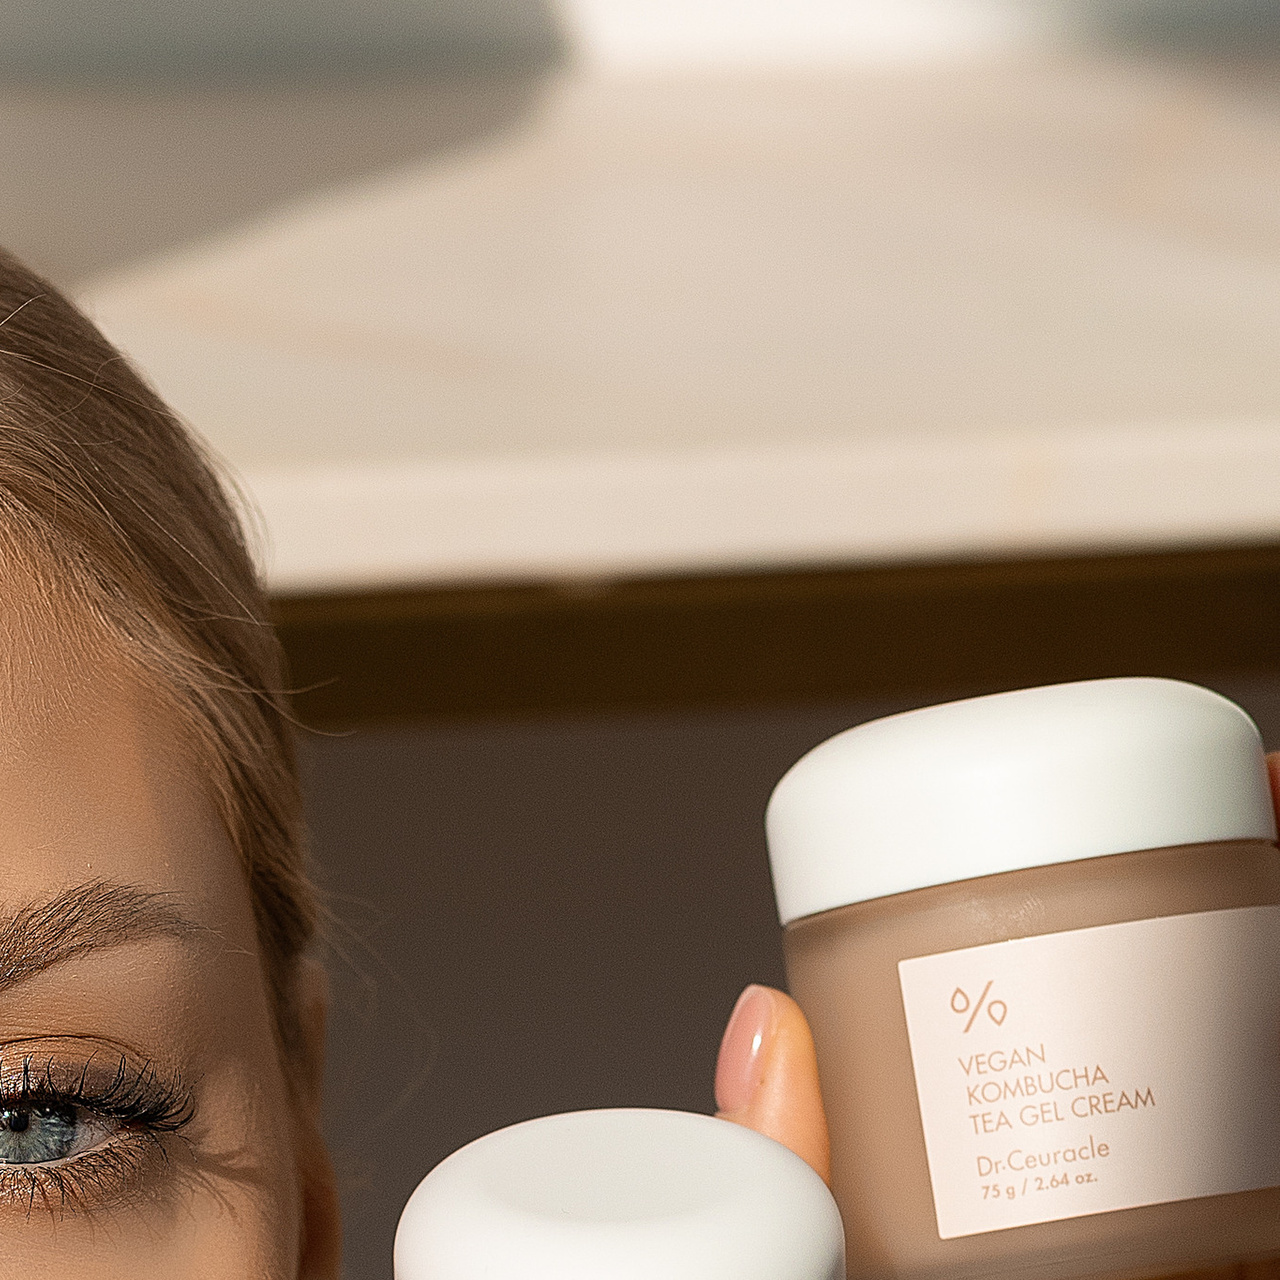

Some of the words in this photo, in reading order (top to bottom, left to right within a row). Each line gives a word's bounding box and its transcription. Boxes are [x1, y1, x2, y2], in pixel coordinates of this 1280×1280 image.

[957, 1043, 1046, 1076] VEGAN
[966, 1064, 1110, 1106] KOMBUCHA
[968, 1111, 1013, 1135] TEA
[1019, 1101, 1065, 1127] GEL
[1070, 1086, 1156, 1119] CREAM
[976, 1134, 1110, 1177] Dr.Ceuracle
[981, 1184, 1001, 1200] 75
[1005, 1185, 1016, 1200] g
[1035, 1173, 1070, 1192] 2.64
[1074, 1172, 1098, 1186] oz.
